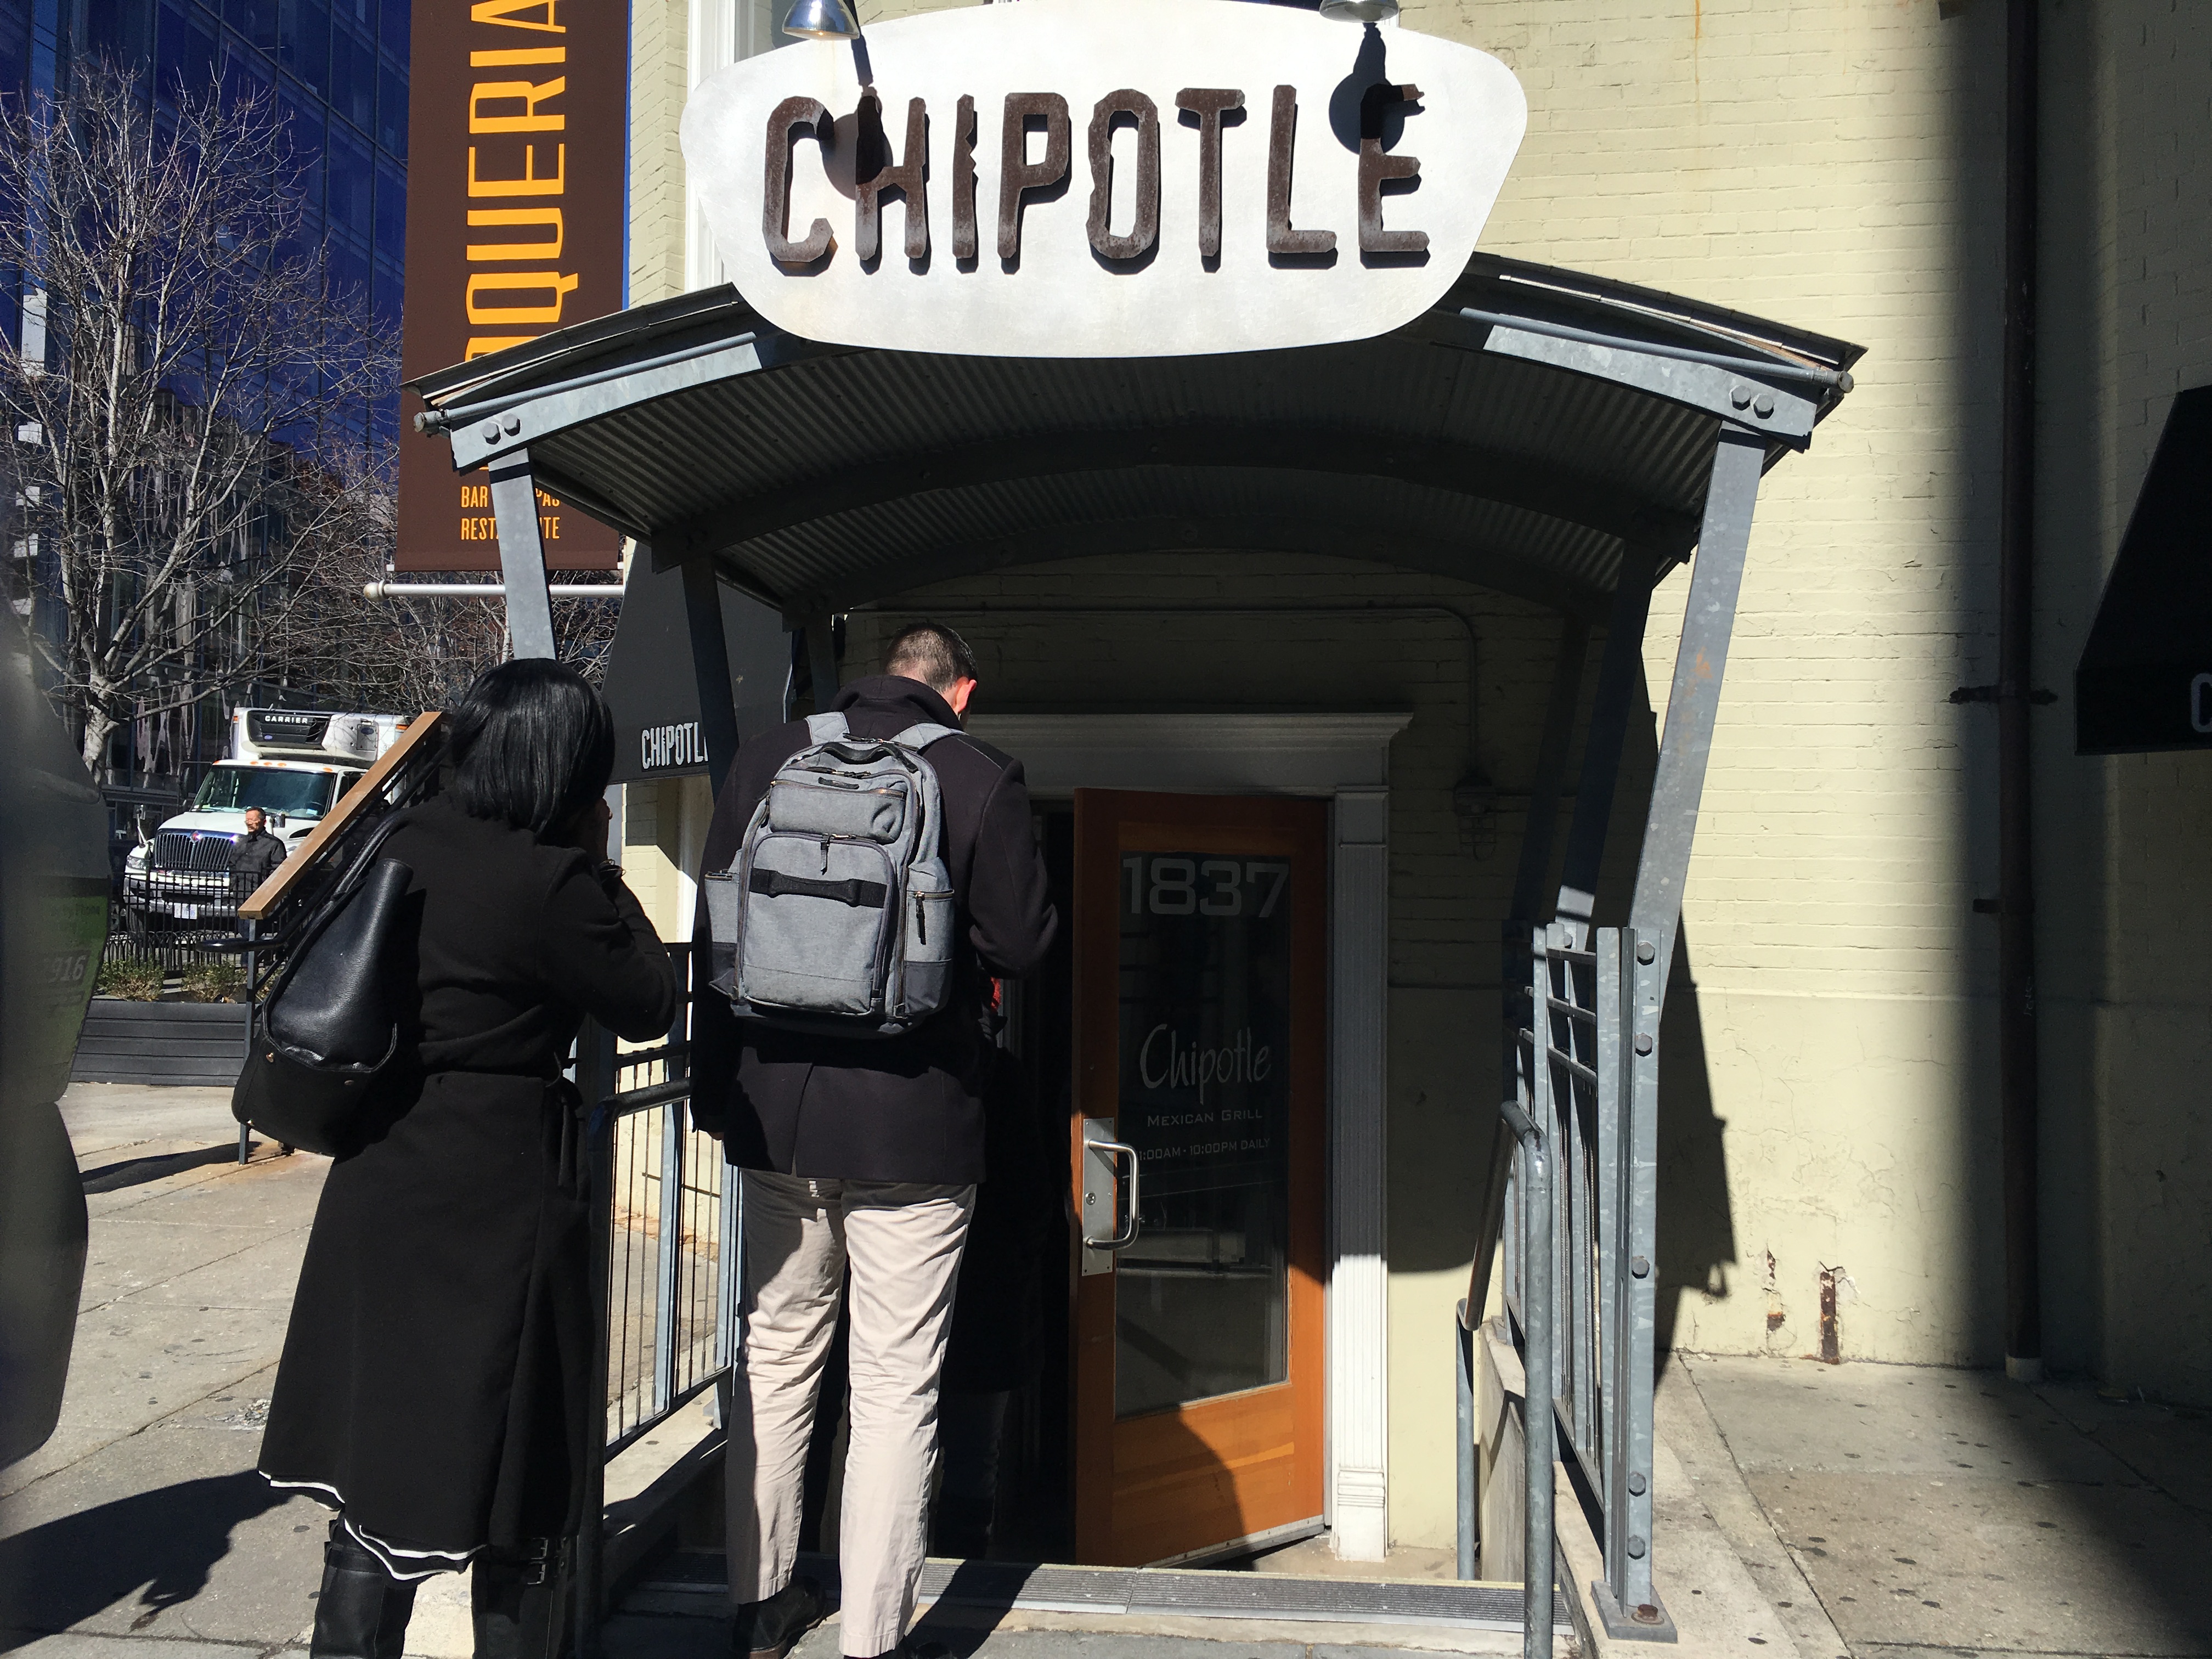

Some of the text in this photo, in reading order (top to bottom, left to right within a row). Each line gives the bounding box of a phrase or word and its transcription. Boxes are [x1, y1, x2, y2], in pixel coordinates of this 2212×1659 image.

[761, 83, 1430, 263] CHIPOTLE
[464, 0, 578, 470] QUERIA
[461, 486, 488, 507] BAR
[264, 715, 308, 724] CARRIER
[641, 722, 708, 769] CHIPOTL
[1122, 856, 1289, 918] 1837
[1139, 1024, 1272, 1105] Chipotle
[1147, 1109, 1263, 1127] MEXICAN GRILL
[1138, 1147, 1181, 1161] 1:00AM
[1190, 1141, 1238, 1156] 10:00PM
[1240, 1138, 1271, 1150] DAILY
